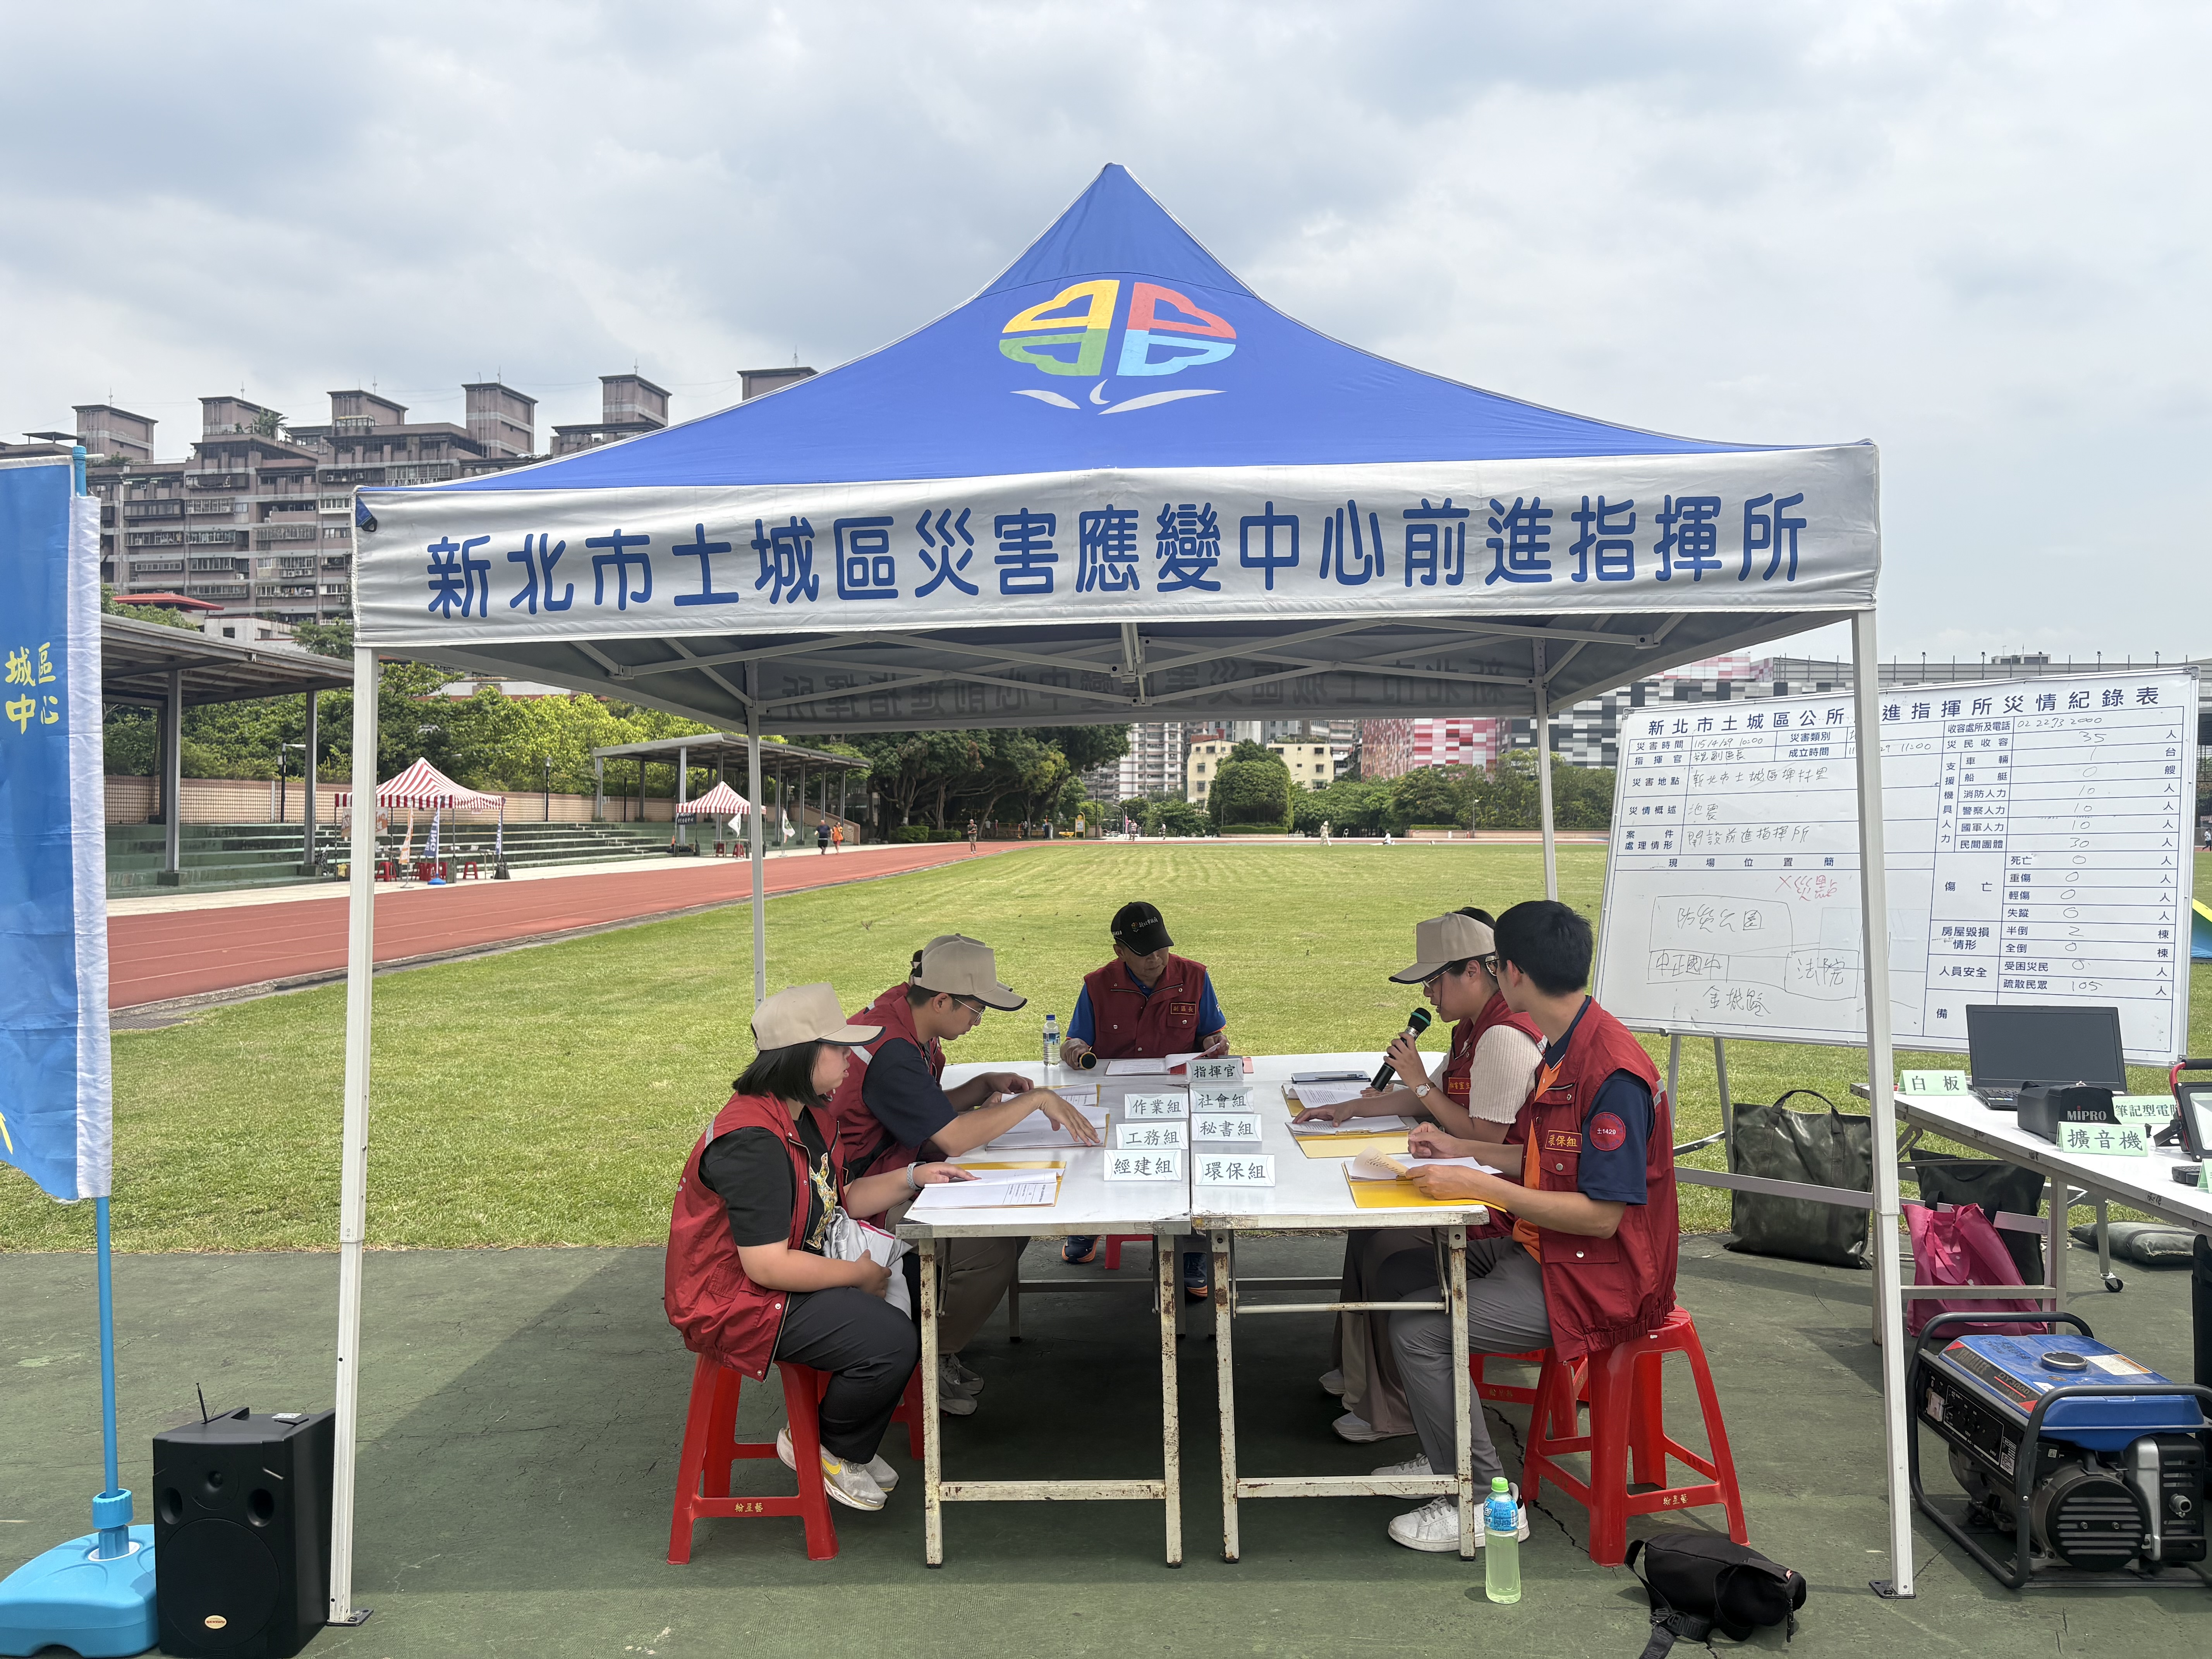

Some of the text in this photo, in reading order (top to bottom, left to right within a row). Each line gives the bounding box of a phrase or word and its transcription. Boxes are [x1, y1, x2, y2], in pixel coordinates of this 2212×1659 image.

[427, 493, 1807, 619] 新北市土城區災害應變中心前進指揮所
[5, 642, 56, 687] 城區
[5, 694, 59, 734] 中心
[1648, 686, 2159, 735] 新北市土城區公所進指揮所災情紀錄表
[2071, 716, 2102, 725] 2000
[1948, 721, 2011, 732] 收容處所及電話
[1790, 732, 1830, 742] 災害類別
[2079, 732, 2107, 743] 35
[2166, 730, 2177, 739] 人
[1637, 741, 1684, 750] 災害時間
[1947, 738, 2008, 749] 災民收容
[1789, 747, 1829, 758] 成立時間
[2166, 747, 2176, 757] 台
[1635, 755, 1682, 765] 指揮官
[2082, 766, 2097, 778] 0
[2164, 765, 2176, 776] 艘
[1633, 777, 1680, 787] 災害地點
[1963, 788, 2006, 799] 消防人力
[2078, 785, 2095, 796] 10
[2164, 783, 2175, 793] 人
[1629, 805, 1676, 815] 災情概述
[1963, 805, 2005, 816] 警察人力
[2074, 803, 2092, 813] 10
[2162, 801, 2174, 811] 人
[1961, 822, 2004, 833] 國軍人力
[2071, 820, 2090, 831] 10
[2162, 819, 2173, 830] 人
[1625, 840, 1673, 850] 處理情形
[1960, 839, 2004, 850] 民間團體
[2069, 838, 2090, 849] 30
[2162, 837, 2172, 848] 人
[2010, 856, 2033, 866] 死亡
[2073, 855, 2087, 865] 0
[2161, 856, 2172, 866] 人
[2009, 873, 2031, 883] 重傷
[2065, 872, 2079, 882] 0
[2160, 874, 2171, 884] 人
[2008, 891, 2030, 900] 輕傷
[2061, 890, 2076, 900] 0
[2159, 892, 2170, 902] 人
[2007, 908, 2029, 918] 失蹤
[2063, 907, 2078, 918] 0
[2159, 911, 2169, 921] 人
[1941, 926, 1990, 938] 房屋毀損
[2006, 926, 2028, 936] 半倒
[2069, 926, 2084, 937] 2
[2158, 929, 2169, 939] 棟
[1953, 940, 1977, 950] 情形
[2006, 943, 2027, 953] 全倒
[2065, 943, 2077, 952] 0
[2157, 948, 2169, 958] 棟
[1797, 957, 1846, 987] 法院
[1939, 966, 1987, 977] 人員安全
[2004, 962, 2049, 972] 受困災民
[2157, 967, 2167, 977] 人
[2003, 979, 2047, 990] 疏散民眾
[2155, 986, 2166, 996] 人
[1937, 1009, 1948, 1019] 備
[1194, 1064, 1236, 1078] 指揮官
[1911, 1076, 1958, 1091] 白板
[1198, 1093, 1247, 1108] 社會組
[1132, 1099, 1182, 1115] 作業組
[1200, 1120, 1254, 1137] 秘書組
[1126, 1129, 1180, 1146] 工務組
[2067, 1128, 2143, 1151] 擴音機
[1113, 1156, 1173, 1176] 經建組
[1204, 1161, 1266, 1181] 環保組
